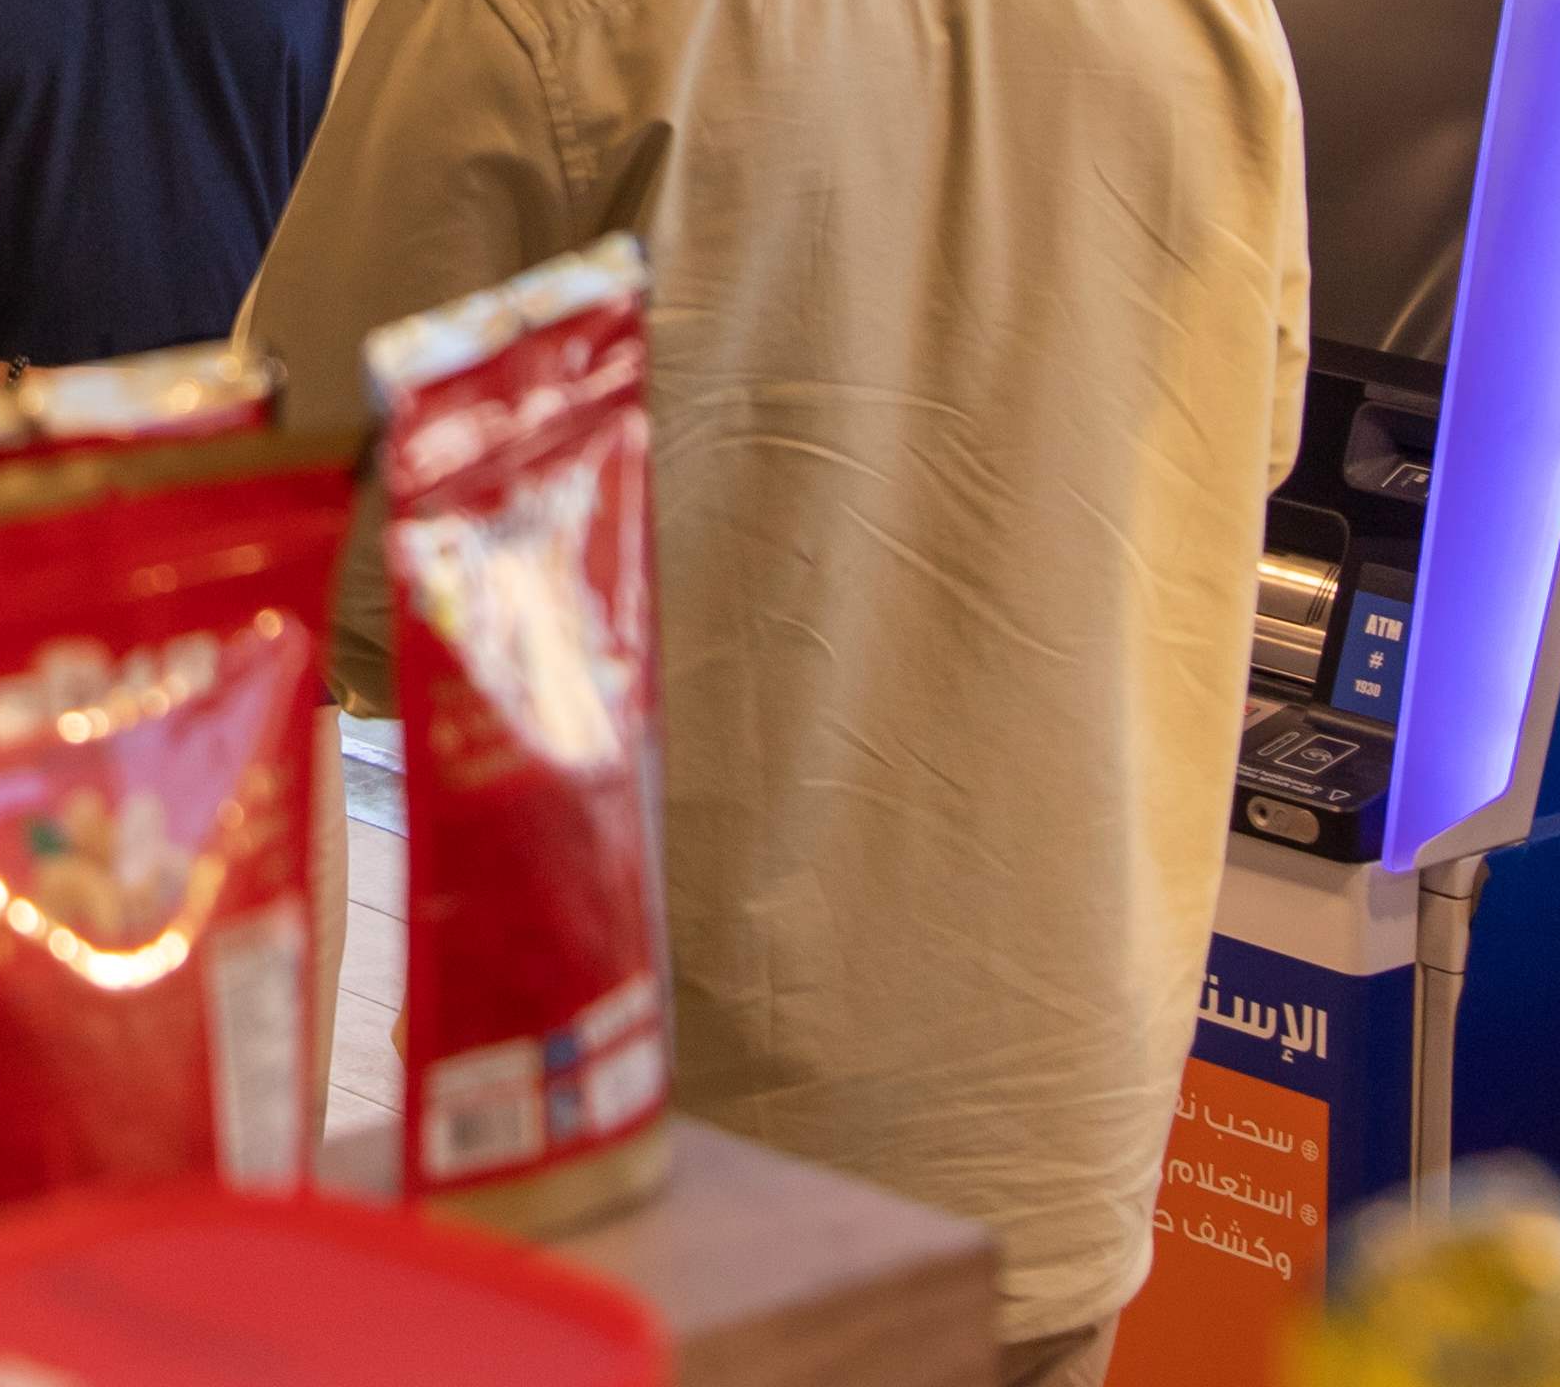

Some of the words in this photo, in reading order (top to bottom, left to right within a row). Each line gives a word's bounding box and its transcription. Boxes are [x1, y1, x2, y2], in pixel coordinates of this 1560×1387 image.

[1365, 613, 1404, 642] ATM
[1204, 1103, 1293, 1154] سحب
[1167, 1158, 1293, 1220] استعلام
[1182, 1212, 1292, 1281] وكشف
